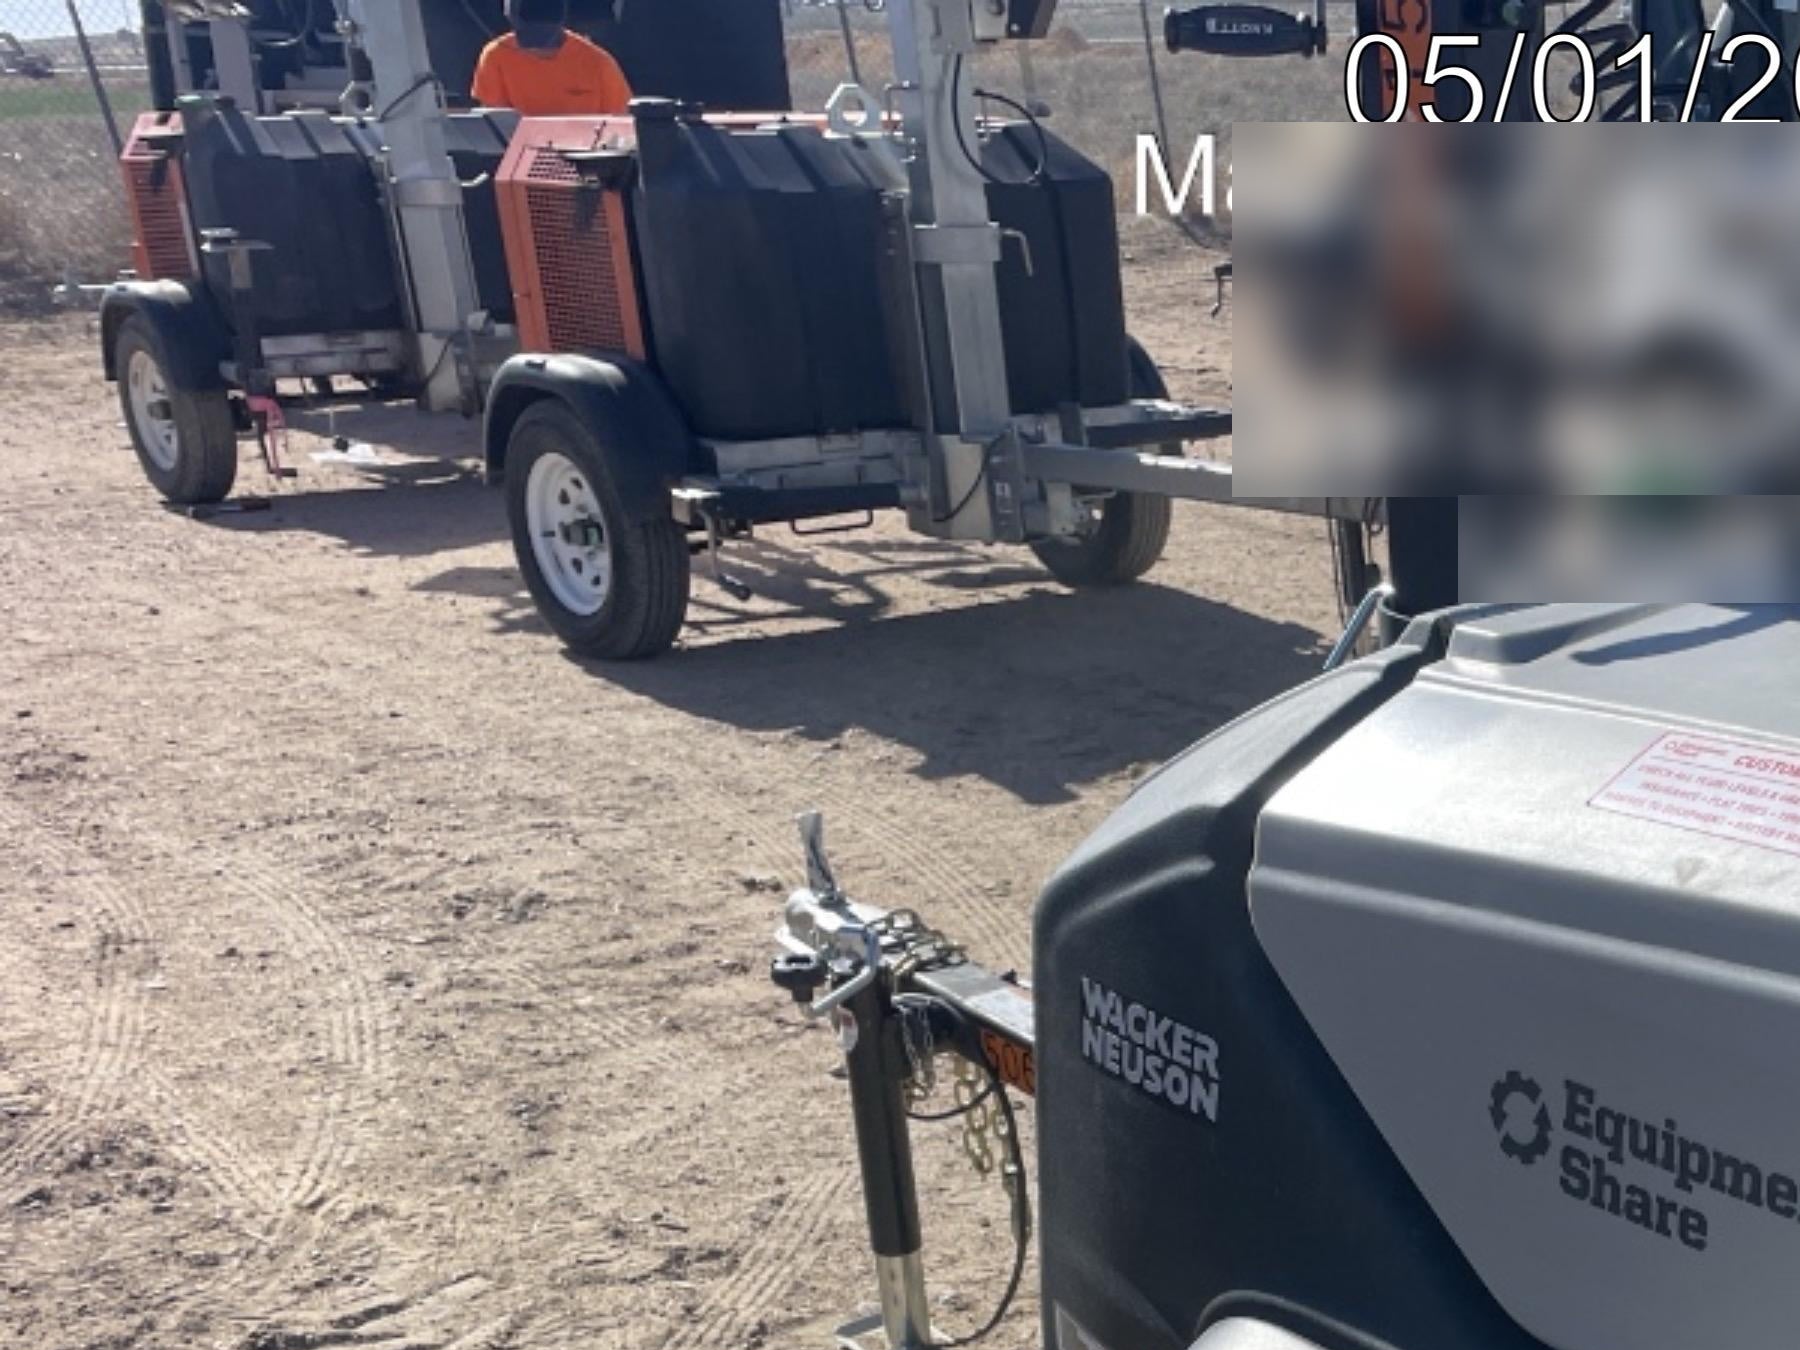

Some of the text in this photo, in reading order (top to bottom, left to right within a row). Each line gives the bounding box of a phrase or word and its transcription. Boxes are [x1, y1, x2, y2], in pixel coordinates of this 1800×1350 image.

[1081, 976, 1221, 1080] WACKER
[1081, 1016, 1219, 1124] NEUSON
[1559, 1144, 1709, 1252] Share
